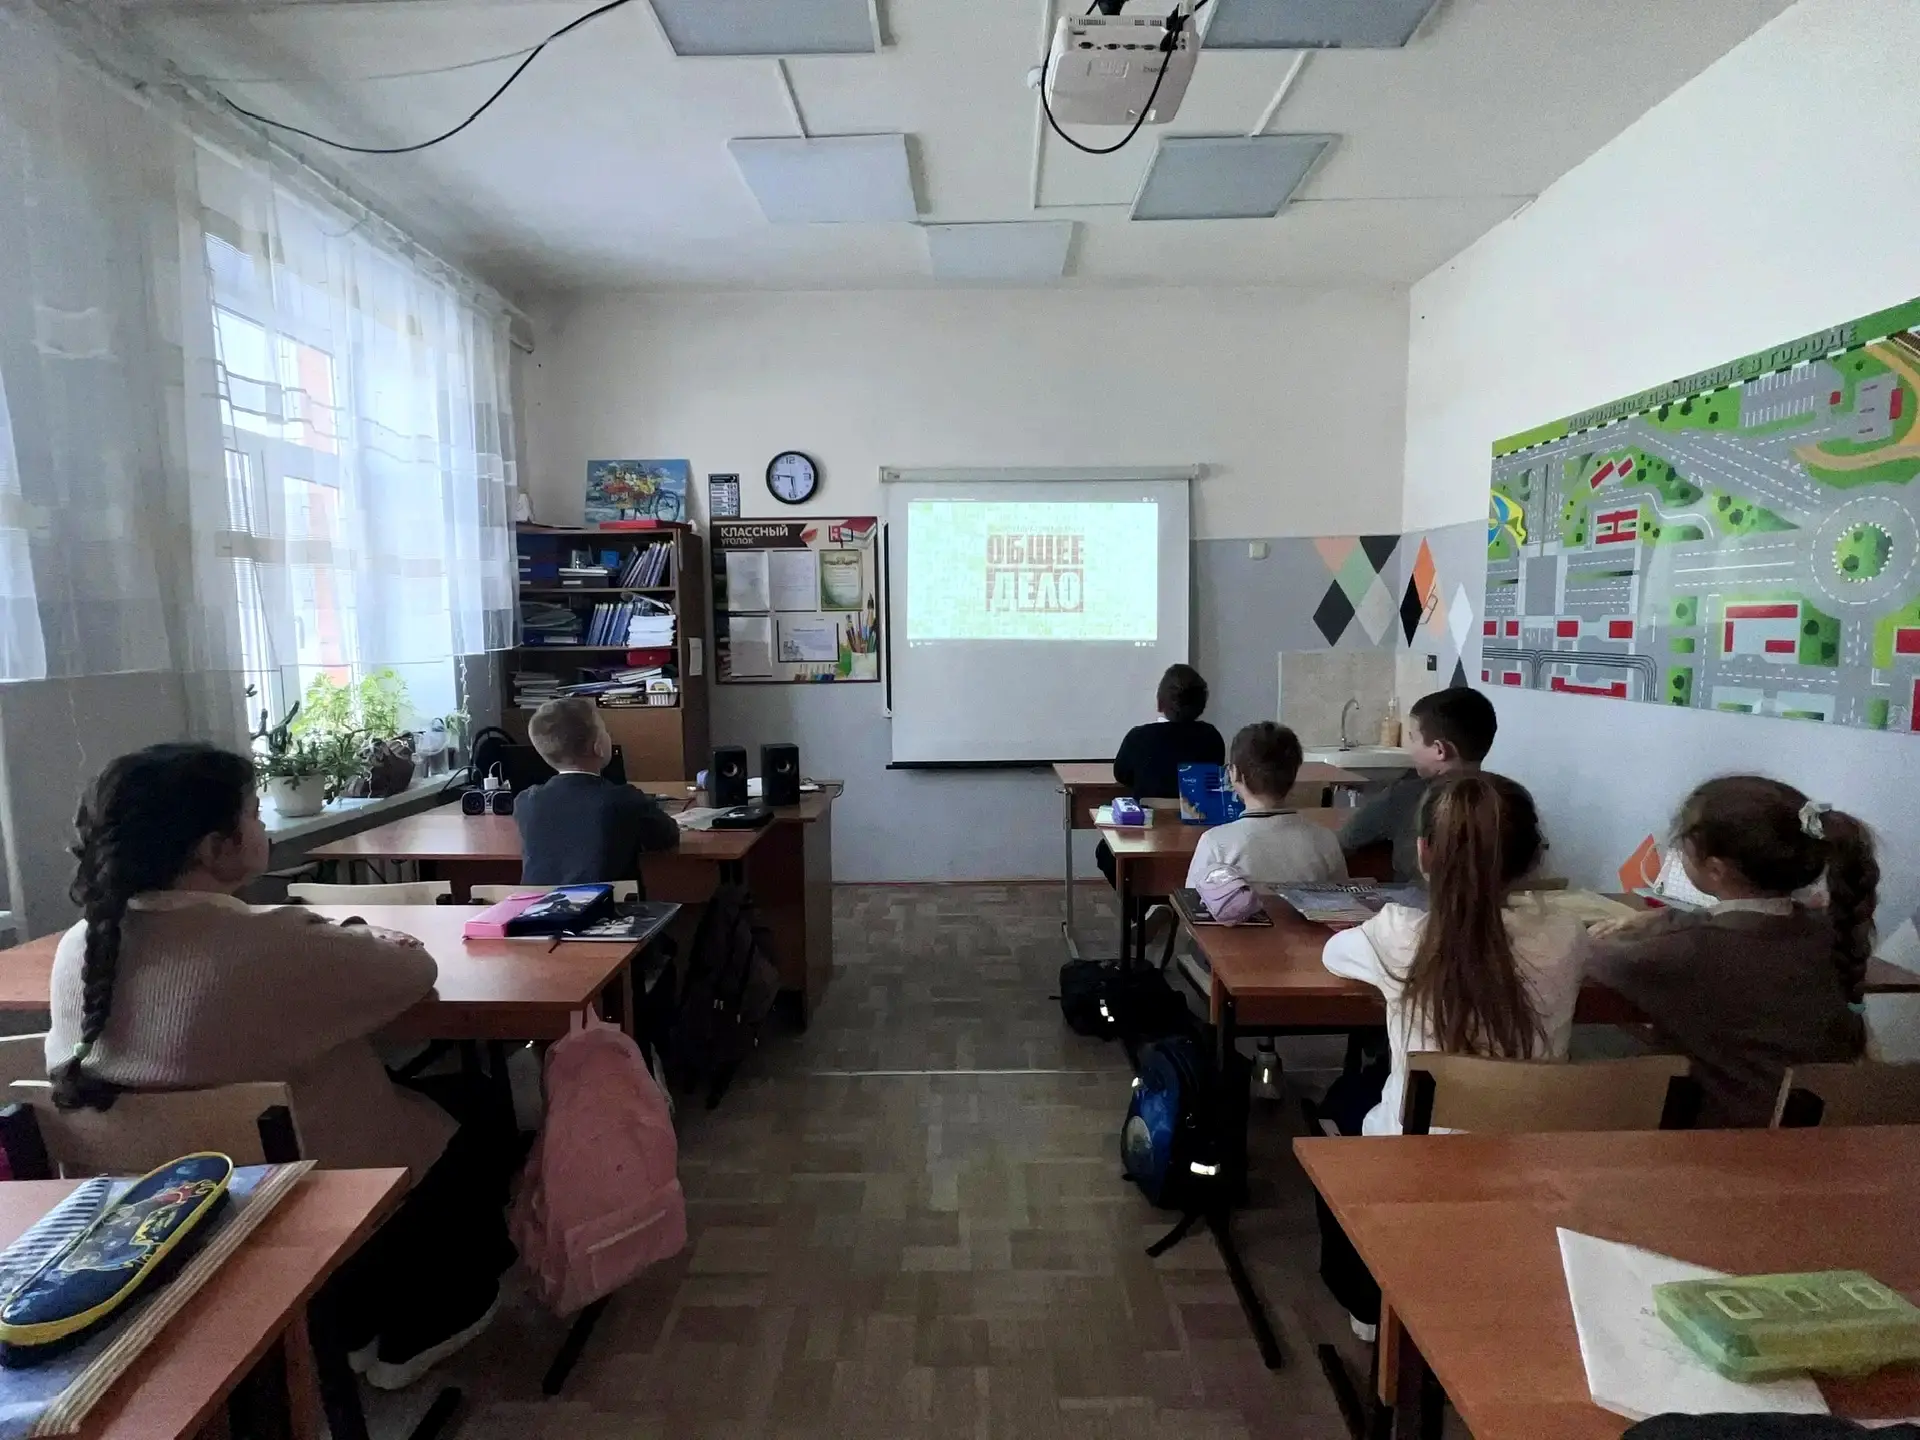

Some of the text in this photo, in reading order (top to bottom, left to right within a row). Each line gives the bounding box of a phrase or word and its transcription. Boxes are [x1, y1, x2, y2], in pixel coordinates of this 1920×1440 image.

[720, 524, 789, 537] КЛАССНЫЙ
[986, 533, 1085, 567] ОБЩЕЕ
[987, 569, 1083, 613] ДЕЛО
